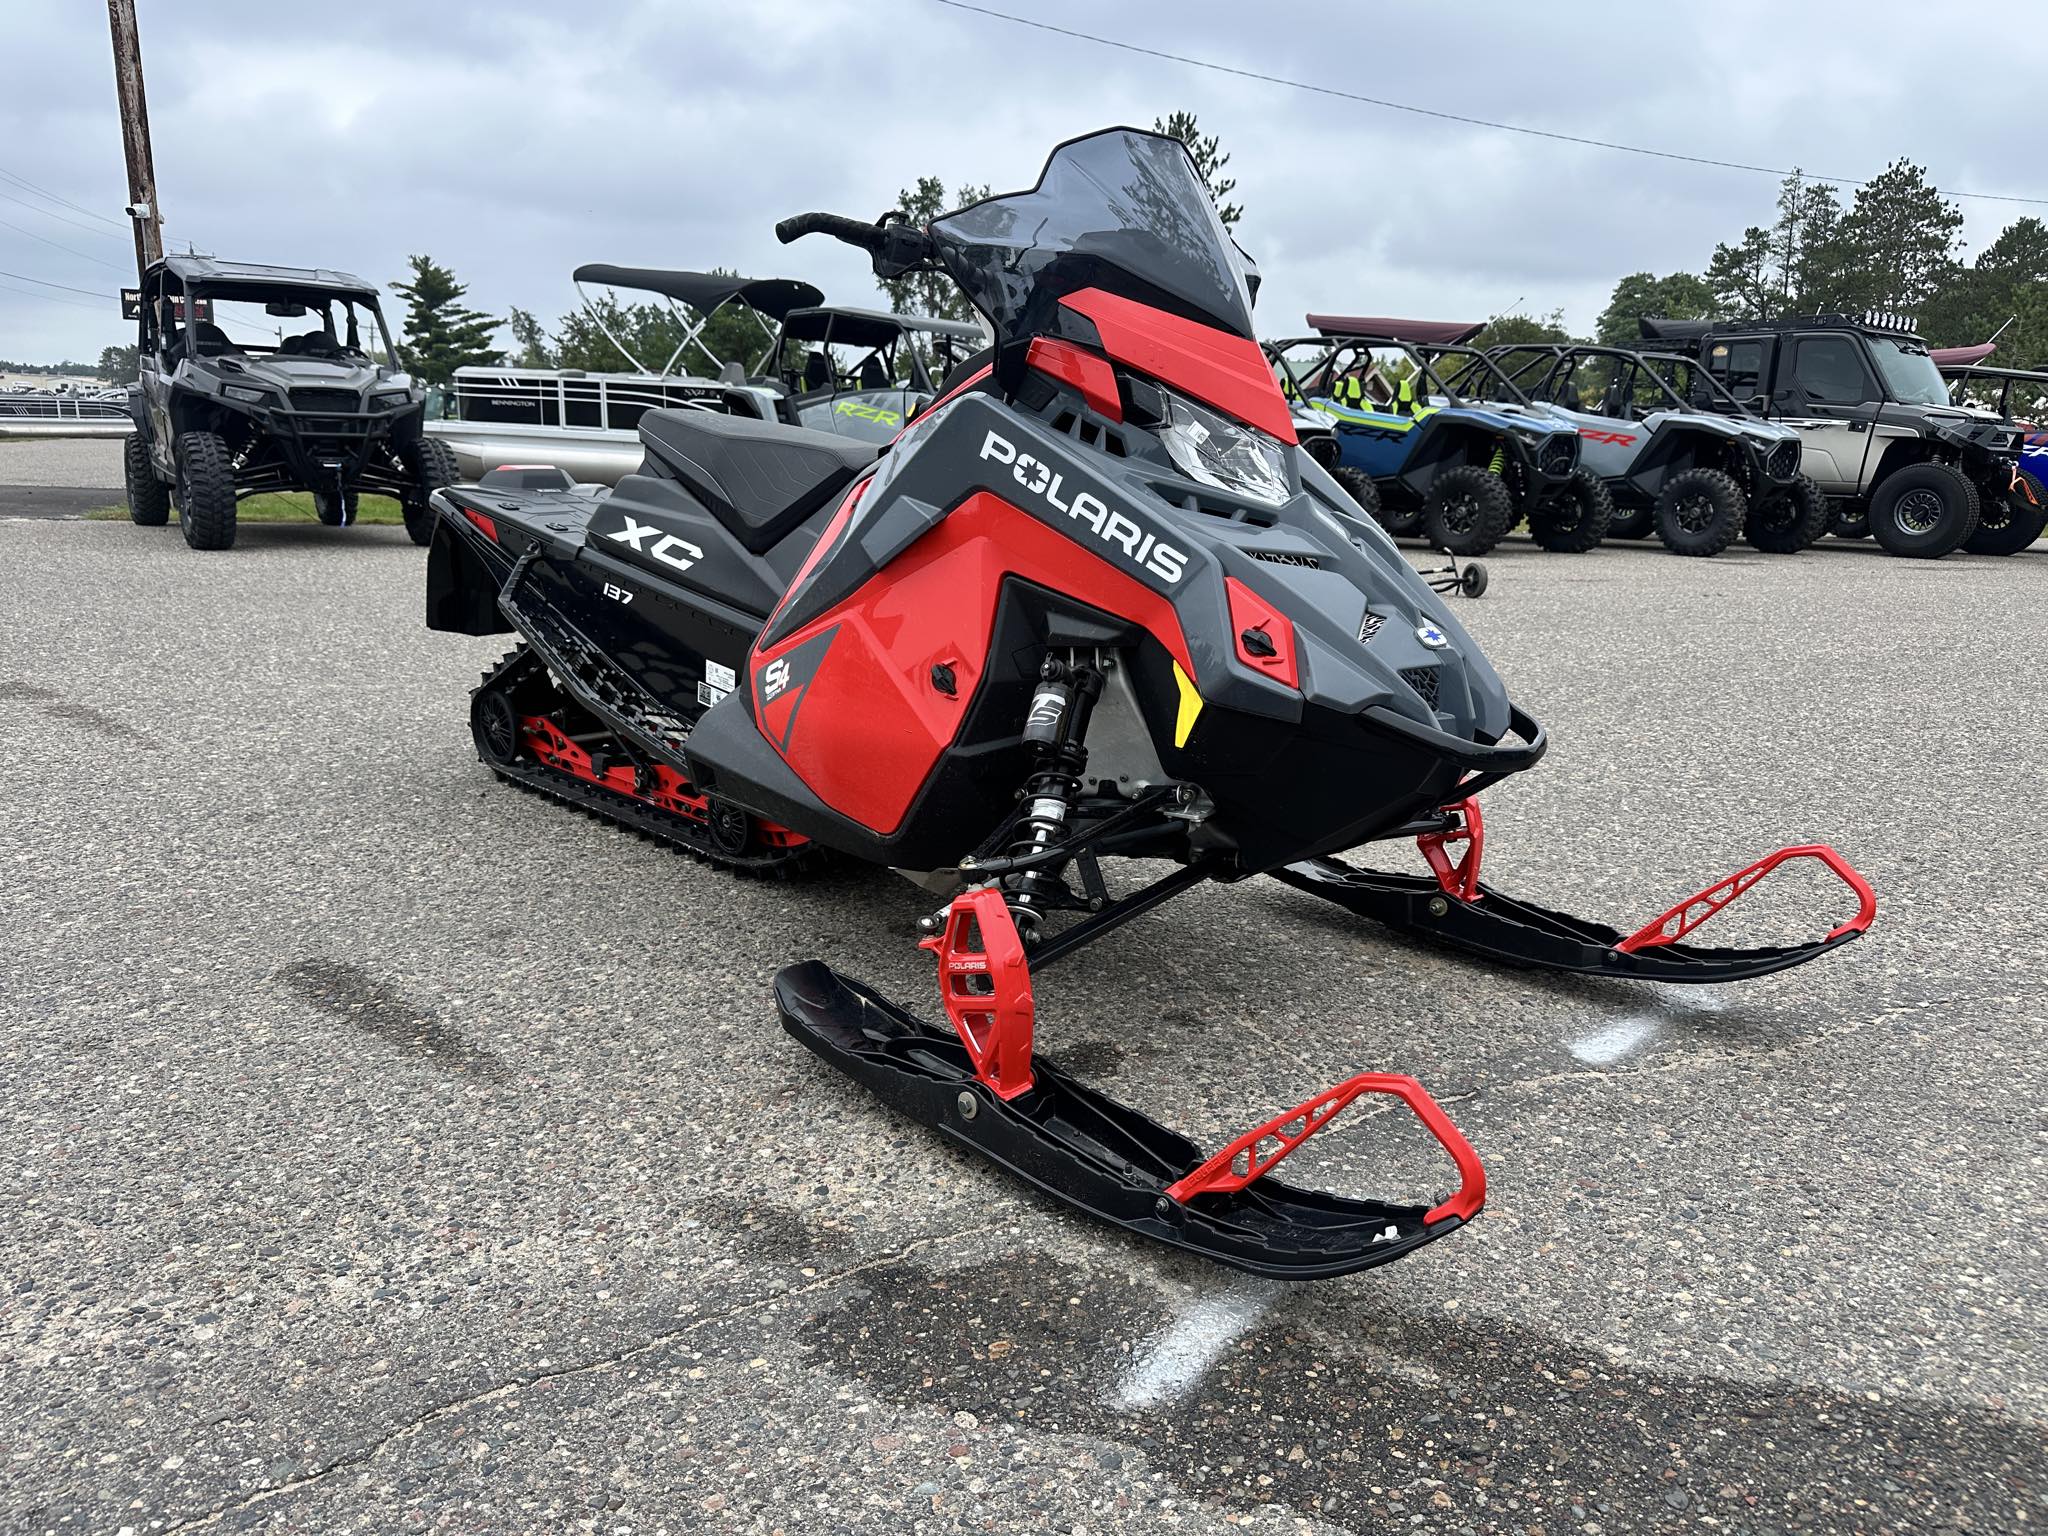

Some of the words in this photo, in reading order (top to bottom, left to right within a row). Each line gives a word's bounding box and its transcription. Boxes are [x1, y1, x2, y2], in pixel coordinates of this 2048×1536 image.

[835, 401, 900, 426] RZR
[979, 430, 1189, 584] POLARIS
[606, 515, 705, 571] XC
[603, 582, 634, 605] 137
[764, 658, 790, 695] S4
[948, 961, 987, 970] POLARIS
